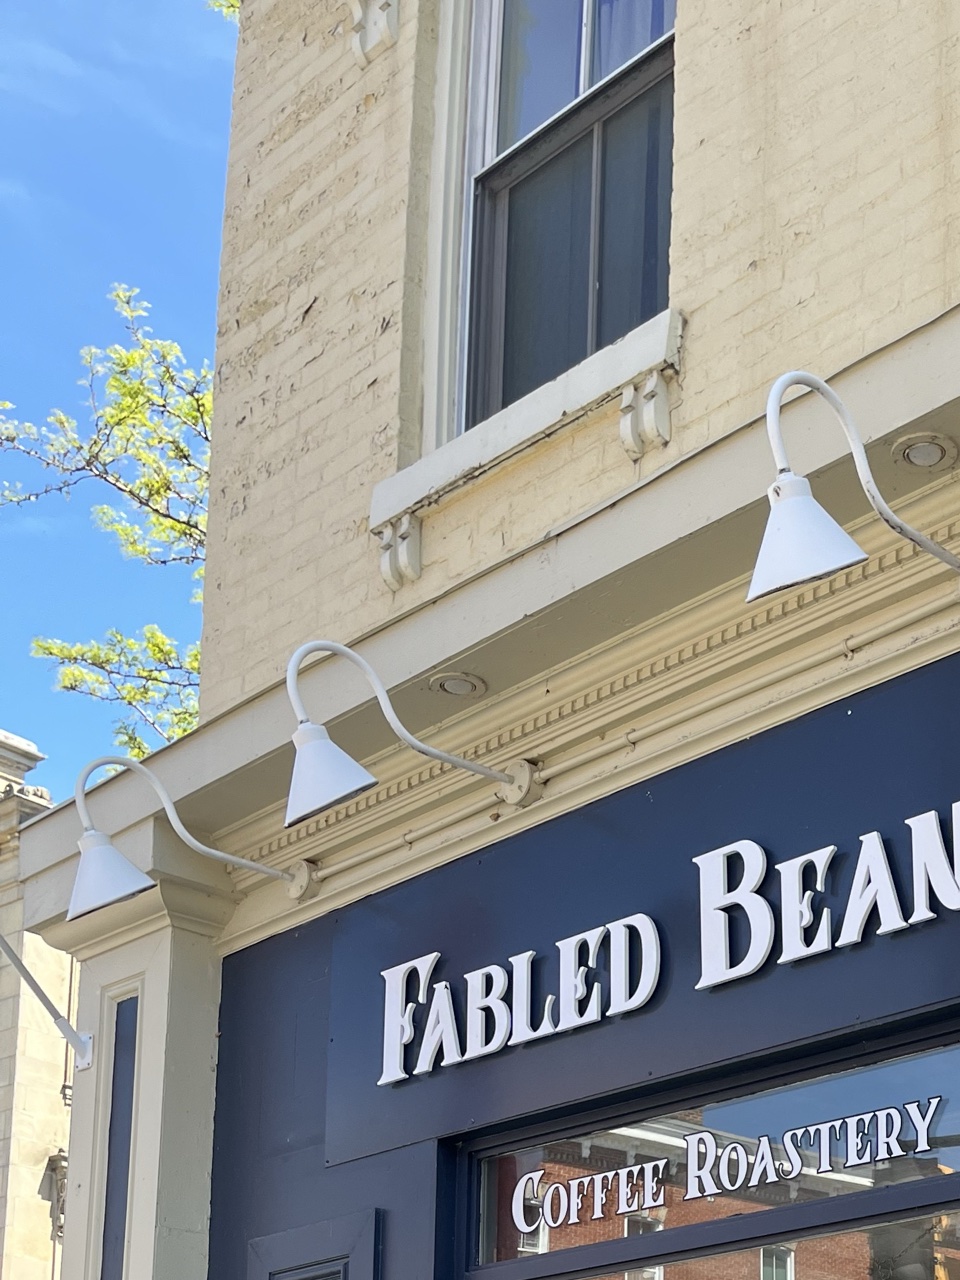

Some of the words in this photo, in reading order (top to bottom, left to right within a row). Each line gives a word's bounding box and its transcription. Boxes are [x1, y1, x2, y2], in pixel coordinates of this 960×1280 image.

[376, 912, 661, 1087] FABLED
[511, 1158, 669, 1234] COFFEE
[683, 1095, 942, 1201] ROASTERY
